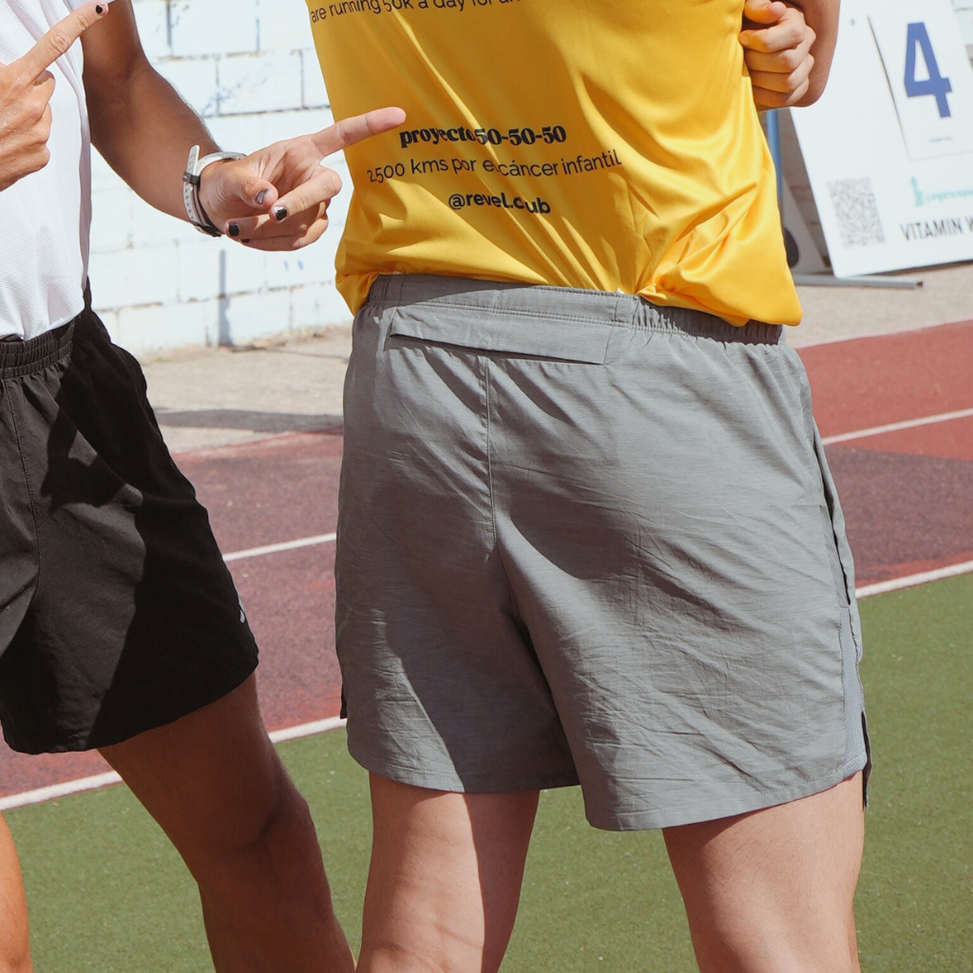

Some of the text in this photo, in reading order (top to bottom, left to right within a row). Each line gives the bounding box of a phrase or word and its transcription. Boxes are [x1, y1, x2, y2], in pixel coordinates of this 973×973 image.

[311, 7, 327, 23] are
[904, 21, 953, 118] 4
[367, 162, 405, 183] 2500
[411, 157, 449, 175] kms
[451, 157, 477, 174] por
[498, 159, 558, 177] cáncer
[561, 149, 622, 176] infantil
[899, 218, 964, 241] VITAMIN
